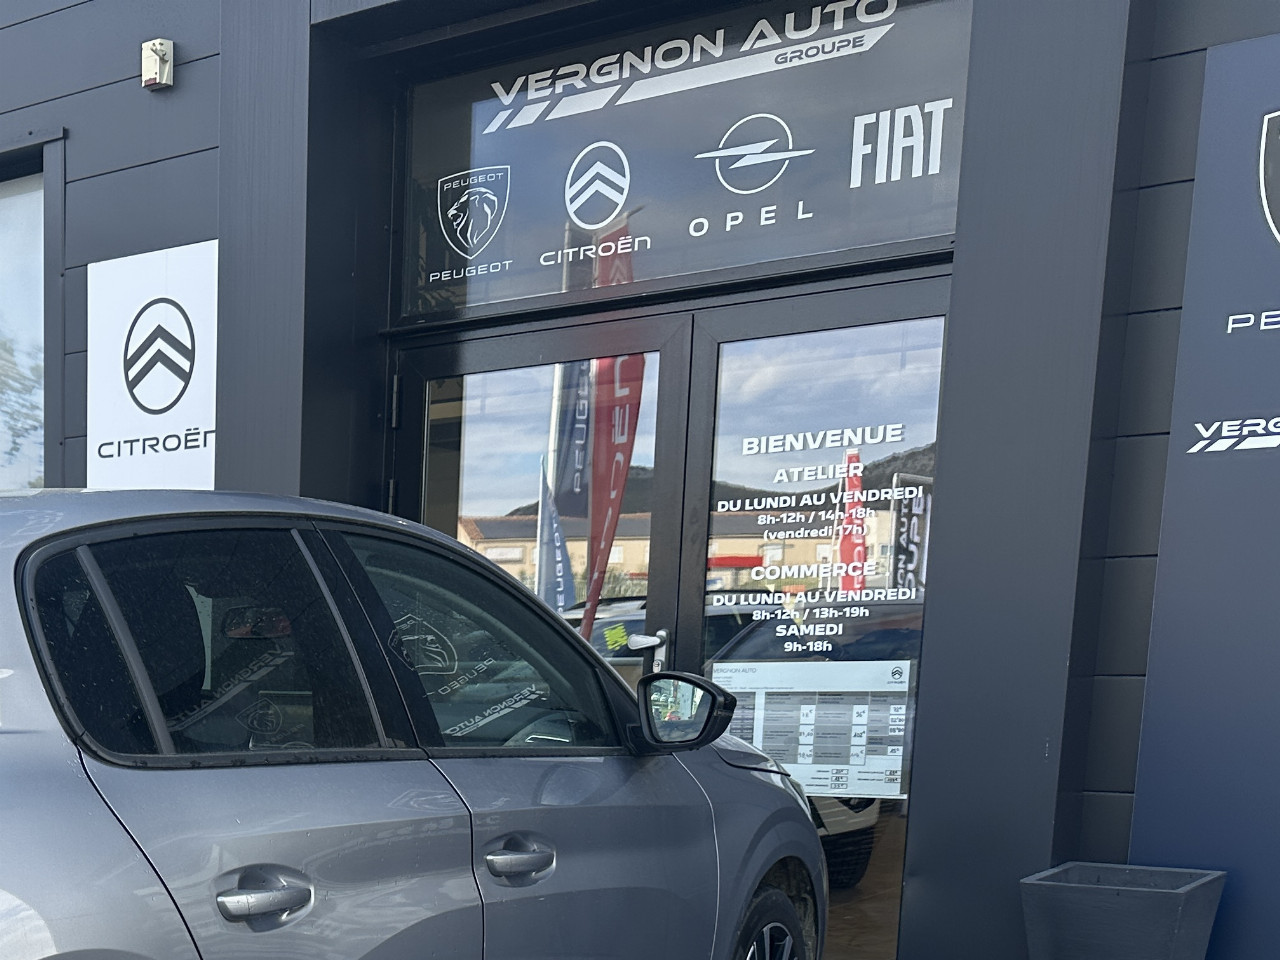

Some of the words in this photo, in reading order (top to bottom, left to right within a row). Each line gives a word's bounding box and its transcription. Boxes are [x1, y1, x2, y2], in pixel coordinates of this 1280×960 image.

[490, 29, 725, 106] VERGNON
[739, 0, 898, 52] AUTO
[775, 34, 865, 65] GROUPE
[849, 98, 954, 189] FIAT
[443, 172, 504, 191] PEUGEOT
[688, 200, 814, 237] OPEL
[429, 260, 513, 283] PEUGEOT
[742, 423, 904, 455] BIENVENUE
[772, 462, 864, 484] ATELIER
[717, 499, 741, 512] DU
[745, 495, 796, 511] LUNDI
[799, 492, 826, 507] AU
[829, 485, 923, 504] VENDREDI
[757, 511, 806, 526] 8h-12h
[818, 507, 875, 522] 14h-18h
[763, 526, 833, 542] (vendredi
[835, 524, 868, 538] 17h)
[751, 561, 878, 580] COMMERCE
[712, 594, 736, 607] DU
[739, 592, 791, 606] LUNDI
[794, 591, 821, 604] AU
[824, 587, 916, 603] VENDREDI
[752, 609, 800, 621] 8h-12h
[812, 606, 869, 619] 13h-19h
[775, 623, 843, 637] SAMEDI
[784, 640, 832, 652] 9h-18h
